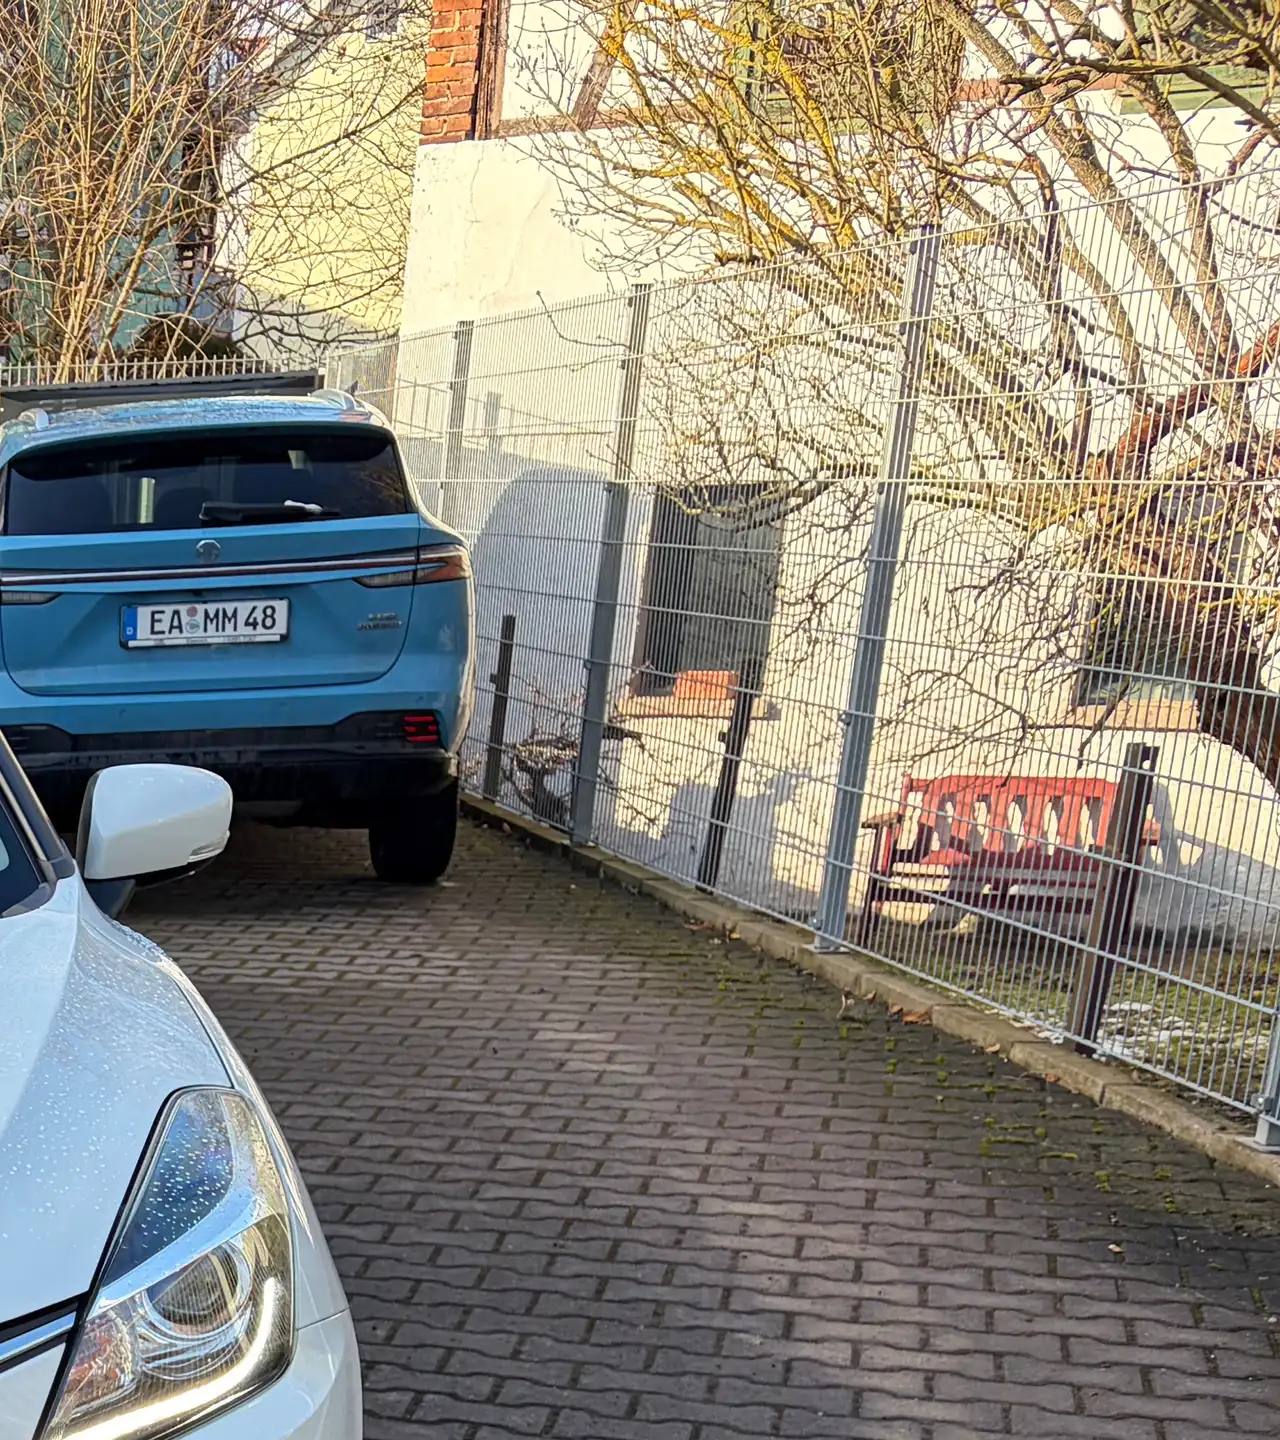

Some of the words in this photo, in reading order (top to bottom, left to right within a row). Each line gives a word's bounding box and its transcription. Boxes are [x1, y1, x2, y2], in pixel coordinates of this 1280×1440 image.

[150, 609, 184, 635] EA
[203, 607, 238, 633] MM
[244, 605, 277, 631] 48
